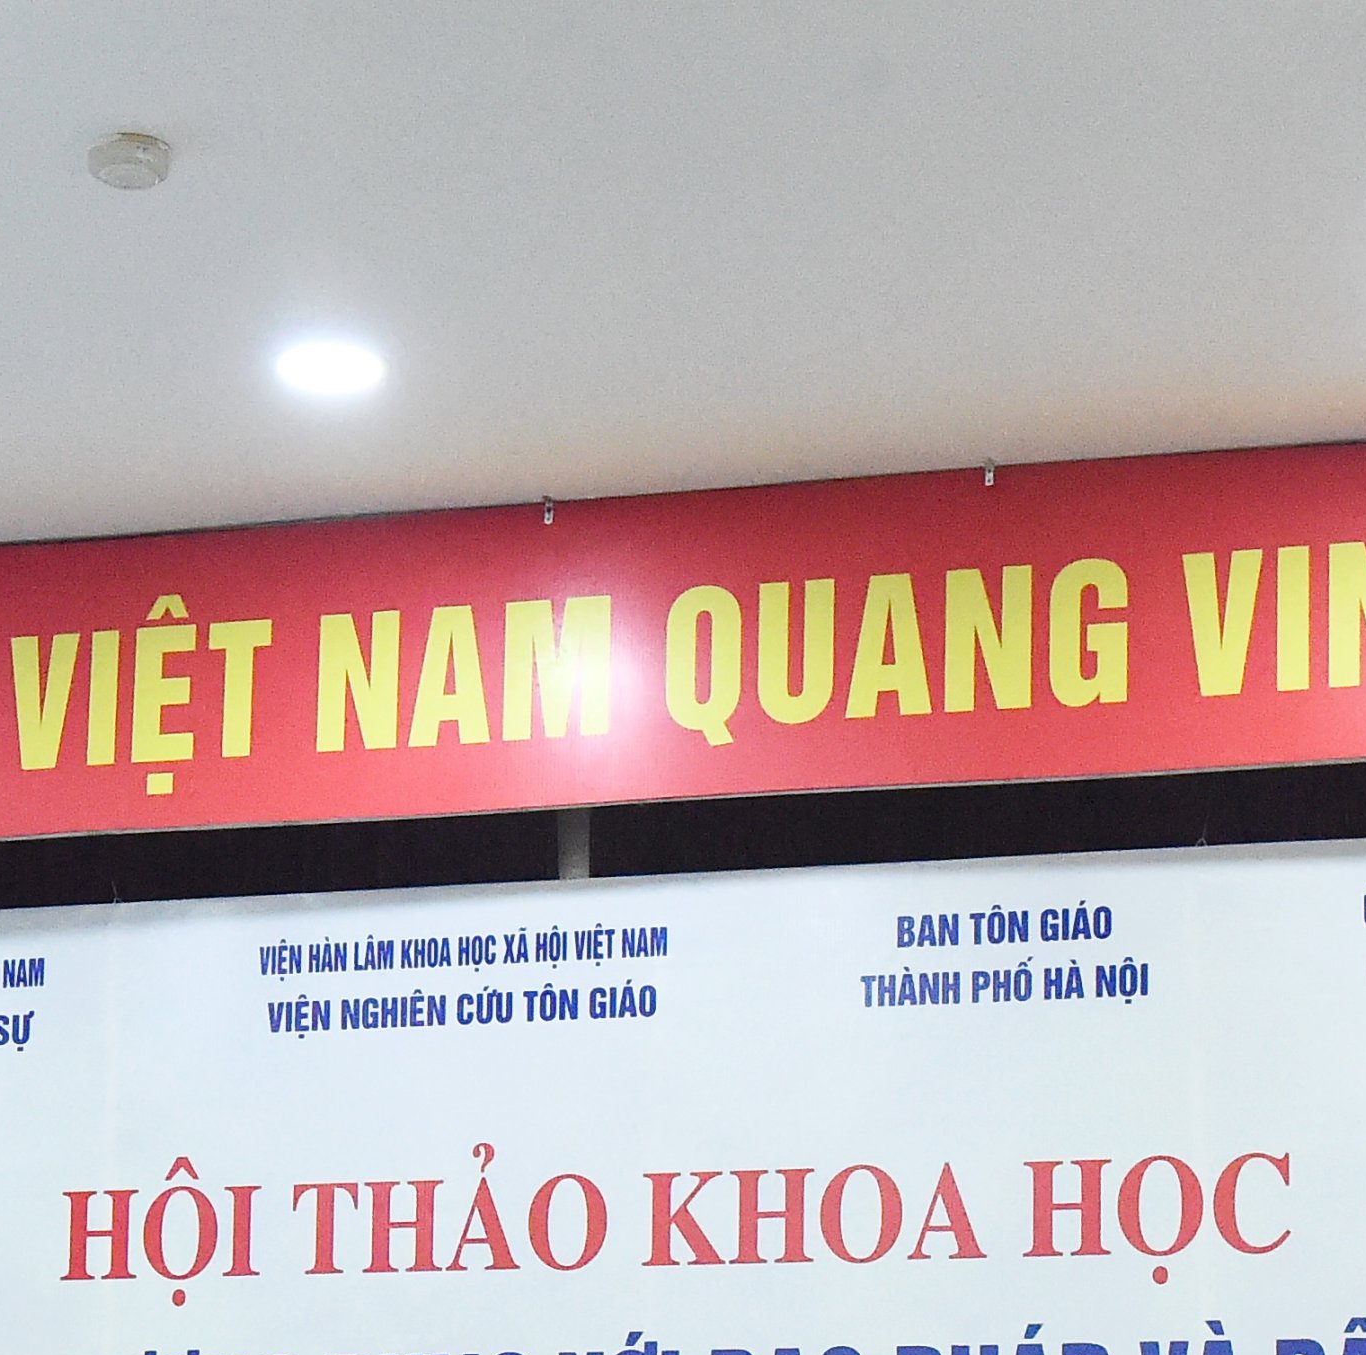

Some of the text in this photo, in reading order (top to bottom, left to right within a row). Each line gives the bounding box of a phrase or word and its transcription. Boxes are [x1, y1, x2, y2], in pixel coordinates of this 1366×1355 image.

[11, 594, 272, 796] VIỆT
[316, 597, 612, 752] NAM
[666, 559, 1129, 747] QUANG
[260, 922, 668, 982] VIỆN HÀN LÂM KHOA HỌC XÃ HỘI VIỆT NAM
[897, 903, 1113, 948] BAN TÔN GIÁO
[2, 957, 46, 989] NAM
[860, 956, 1149, 1008] THÀNH PHỐ HÀ NỘI
[268, 983, 657, 1040] VIỆN NGHIÊN CỨU TÔN GIÁO
[59, 1141, 1294, 1306] HỘI THẢO KHOA HỌC
